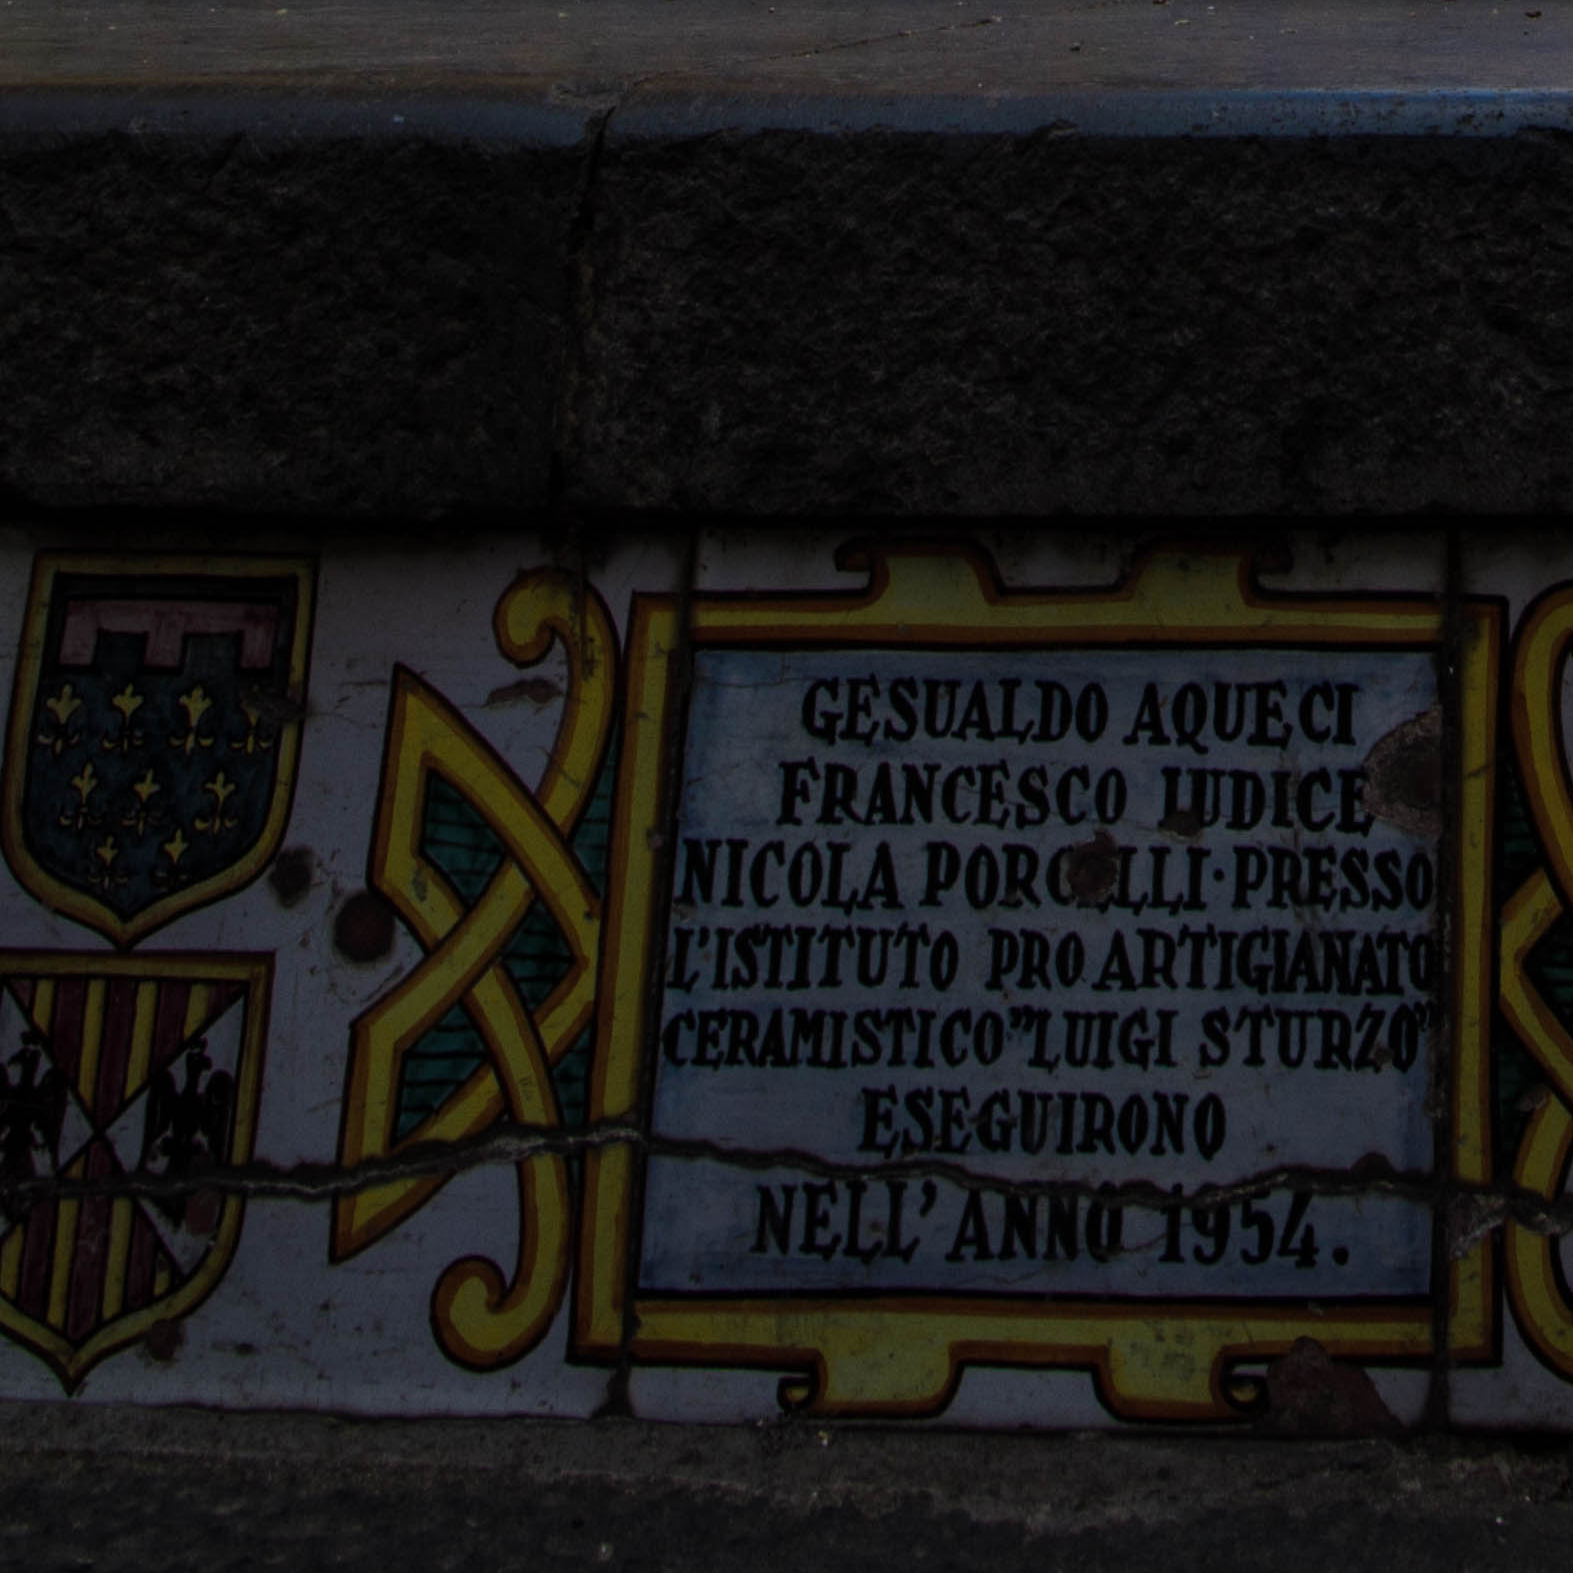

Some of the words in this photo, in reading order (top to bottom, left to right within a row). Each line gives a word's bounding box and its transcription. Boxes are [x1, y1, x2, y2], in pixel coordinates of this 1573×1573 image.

[802, 672, 1109, 747] GESUALDO
[1121, 679, 1360, 754] AQUECI
[775, 755, 1128, 830] FRANCESCO
[1157, 765, 1376, 837] IUDICE
[671, 838, 904, 915] NICOLA
[918, 841, 1212, 916] PORCLLI
[666, 922, 959, 994] L'ISTITUTO
[983, 927, 1085, 992] PRO
[1091, 923, 1436, 995] ARTIGIANATO
[662, 1006, 1005, 1071] CERAMISTICO
[858, 1083, 1227, 1161] ESEGUIRONO
[1157, 1182, 1350, 1269] 1954.
